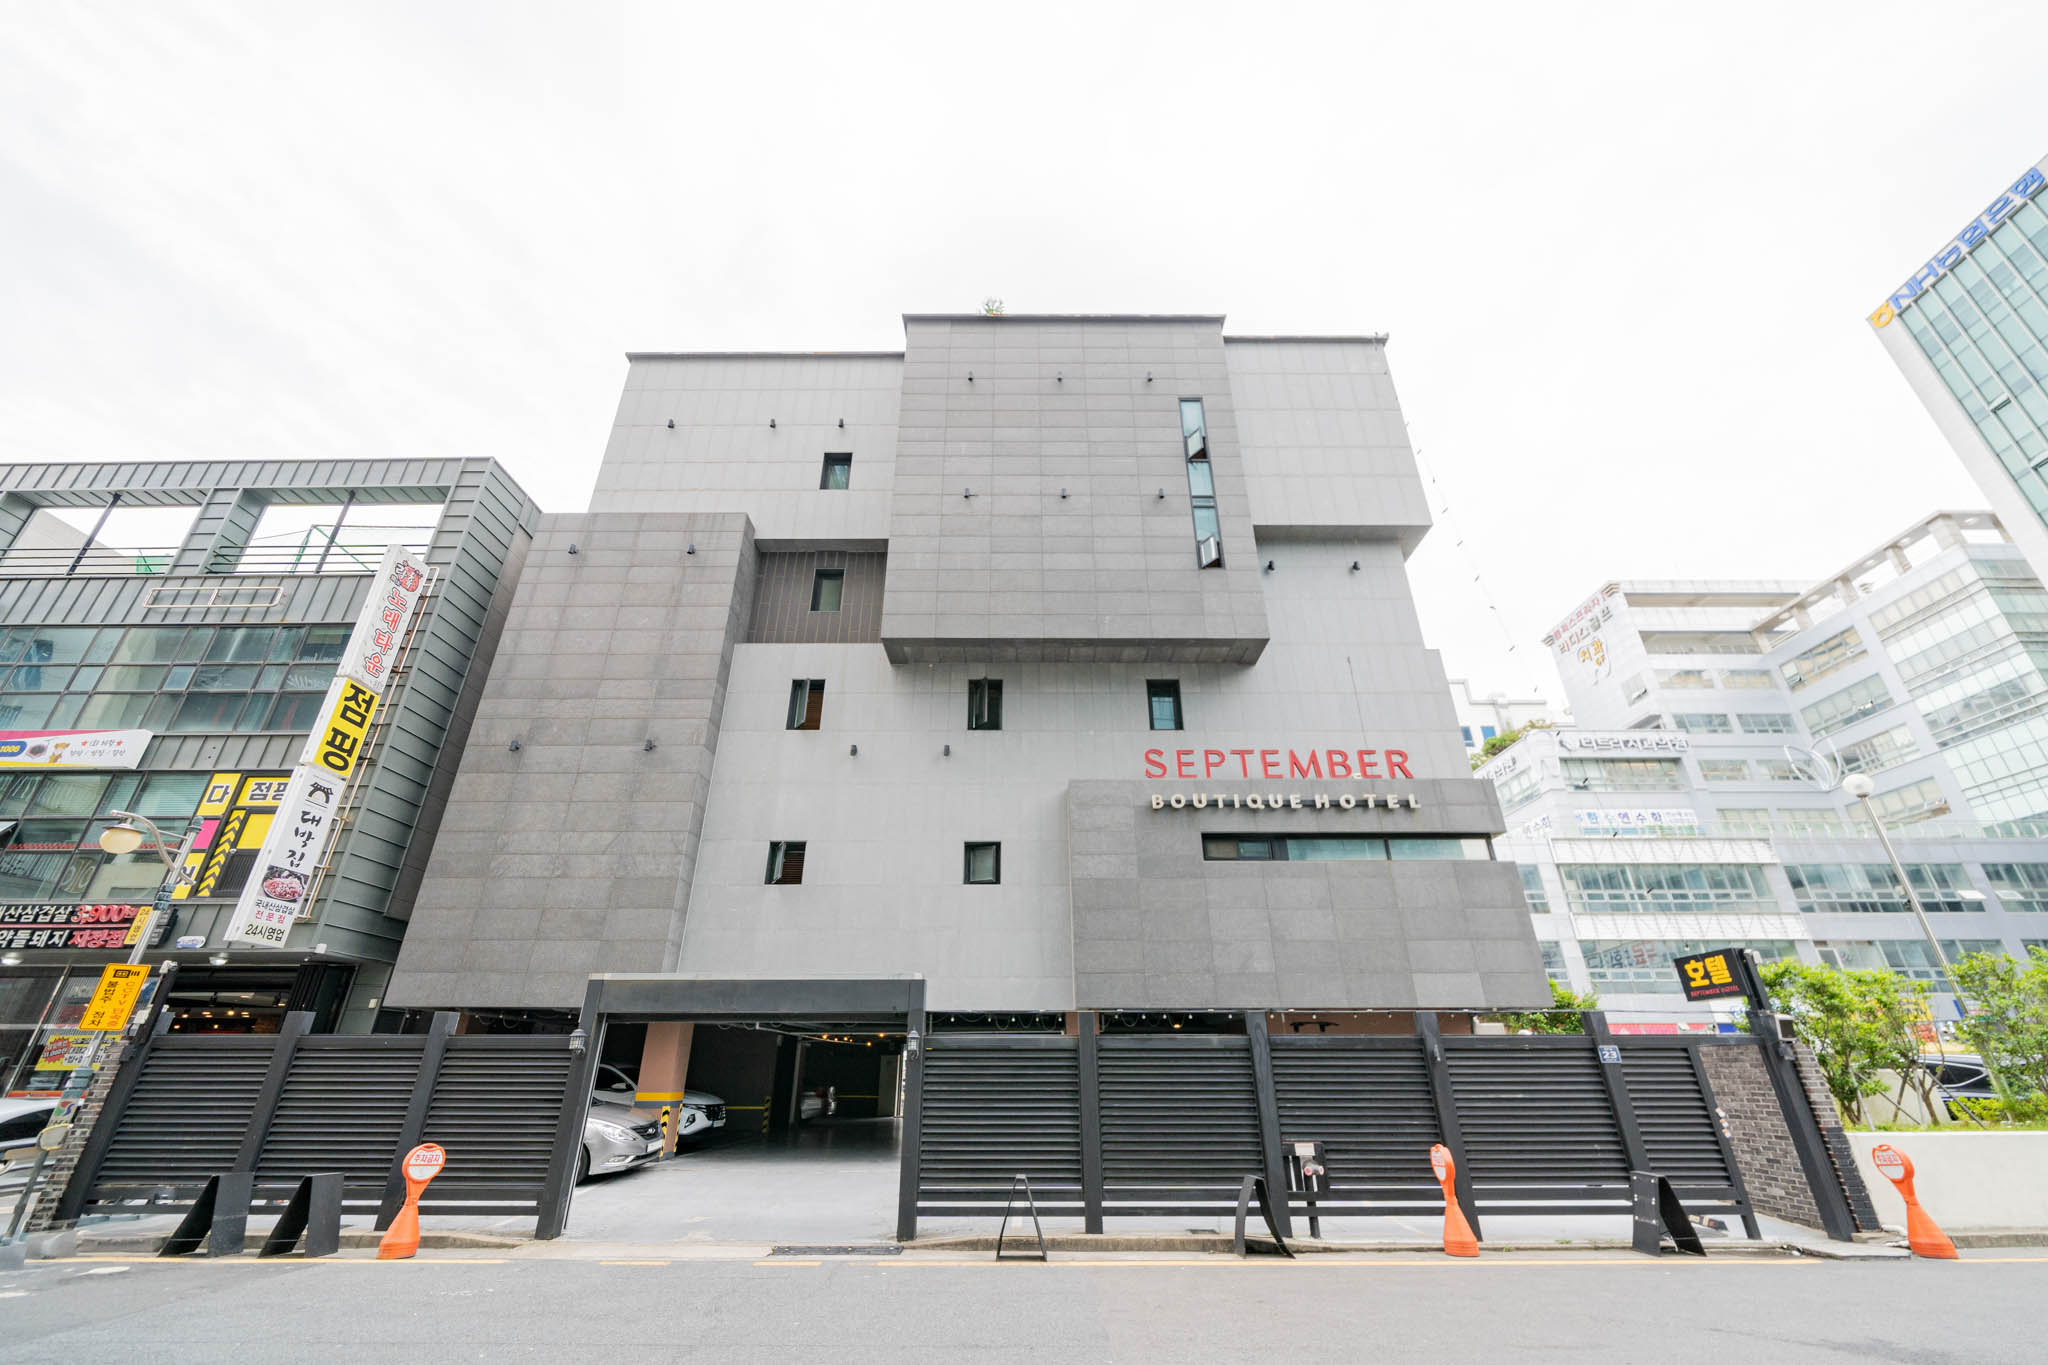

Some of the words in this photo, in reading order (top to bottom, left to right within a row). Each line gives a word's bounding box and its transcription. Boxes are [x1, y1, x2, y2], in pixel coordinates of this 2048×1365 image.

[364, 587, 408, 678] 노래타운
[325, 683, 375, 772] 점핑
[1144, 748, 1414, 779] SEPTEMBER
[1151, 793, 1303, 811] BOUTIQUE
[1314, 793, 1422, 810] HOTEL
[285, 810, 322, 868] 대박집
[245, 923, 285, 942] 24시영업
[1684, 954, 1733, 988] 호텔
[1602, 1050, 1618, 1060] 23
